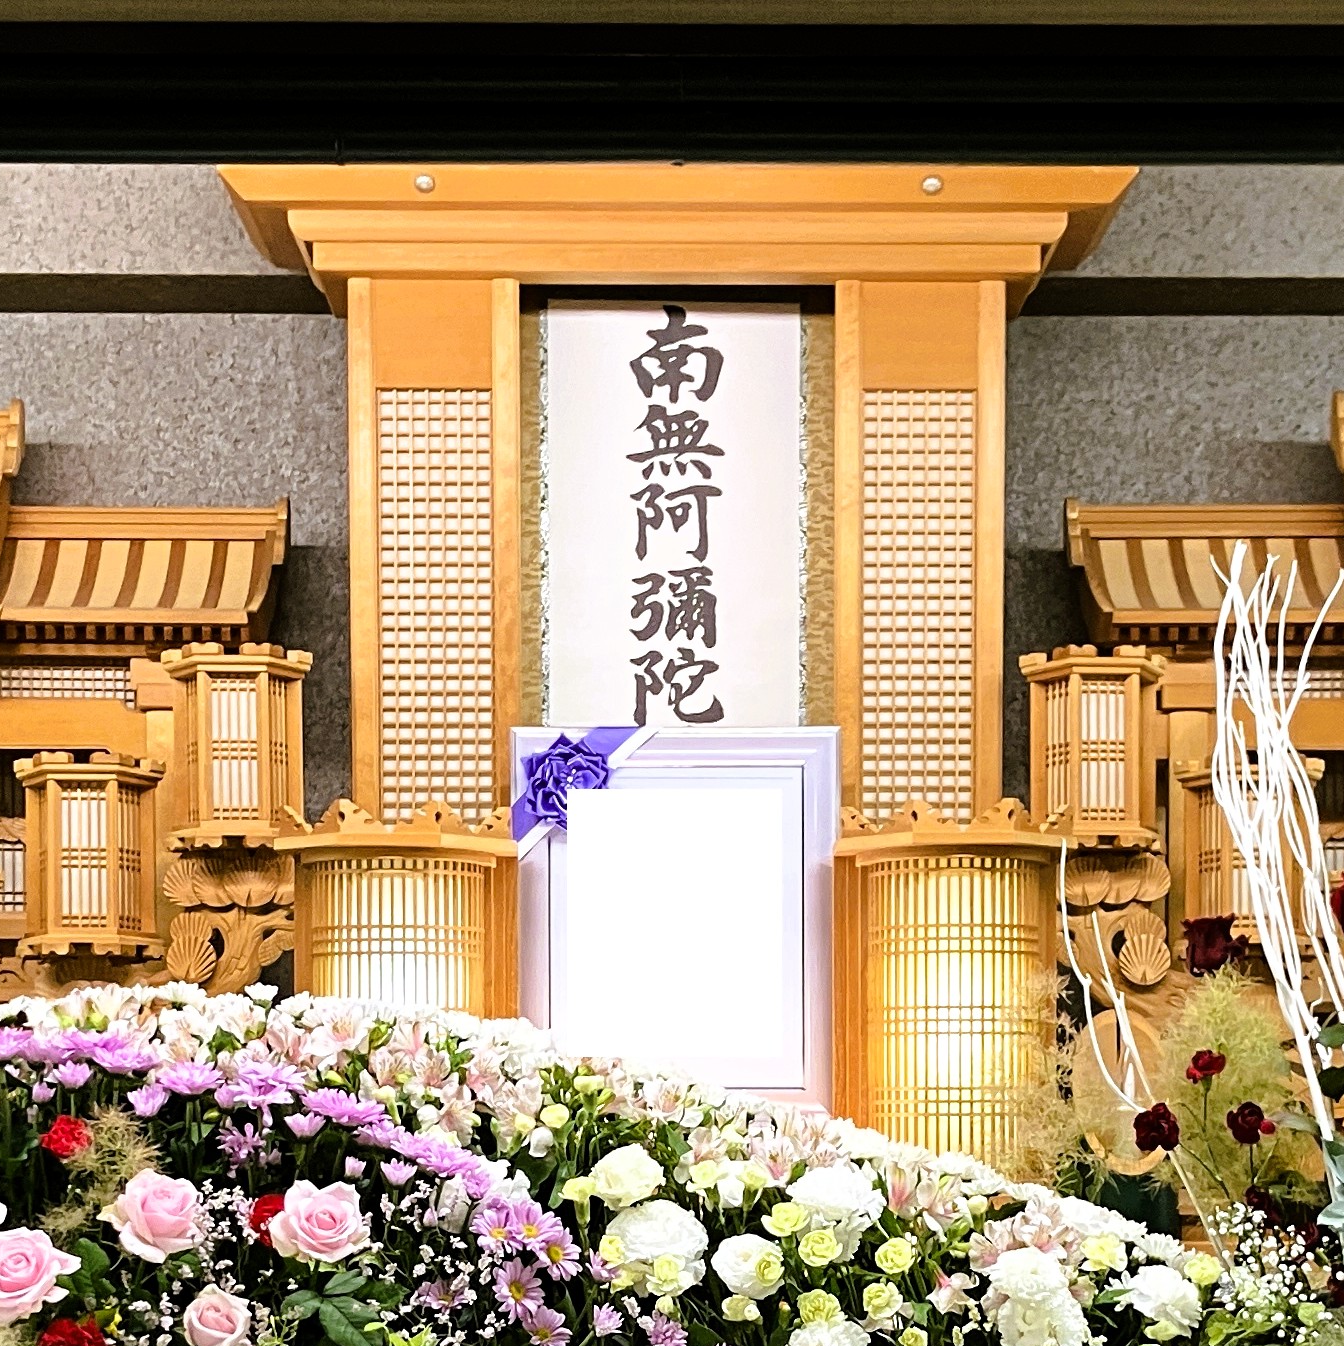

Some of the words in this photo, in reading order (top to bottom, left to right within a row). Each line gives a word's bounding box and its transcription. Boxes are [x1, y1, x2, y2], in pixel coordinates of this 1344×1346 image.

[626, 305, 725, 726] 南無阿彌陀
